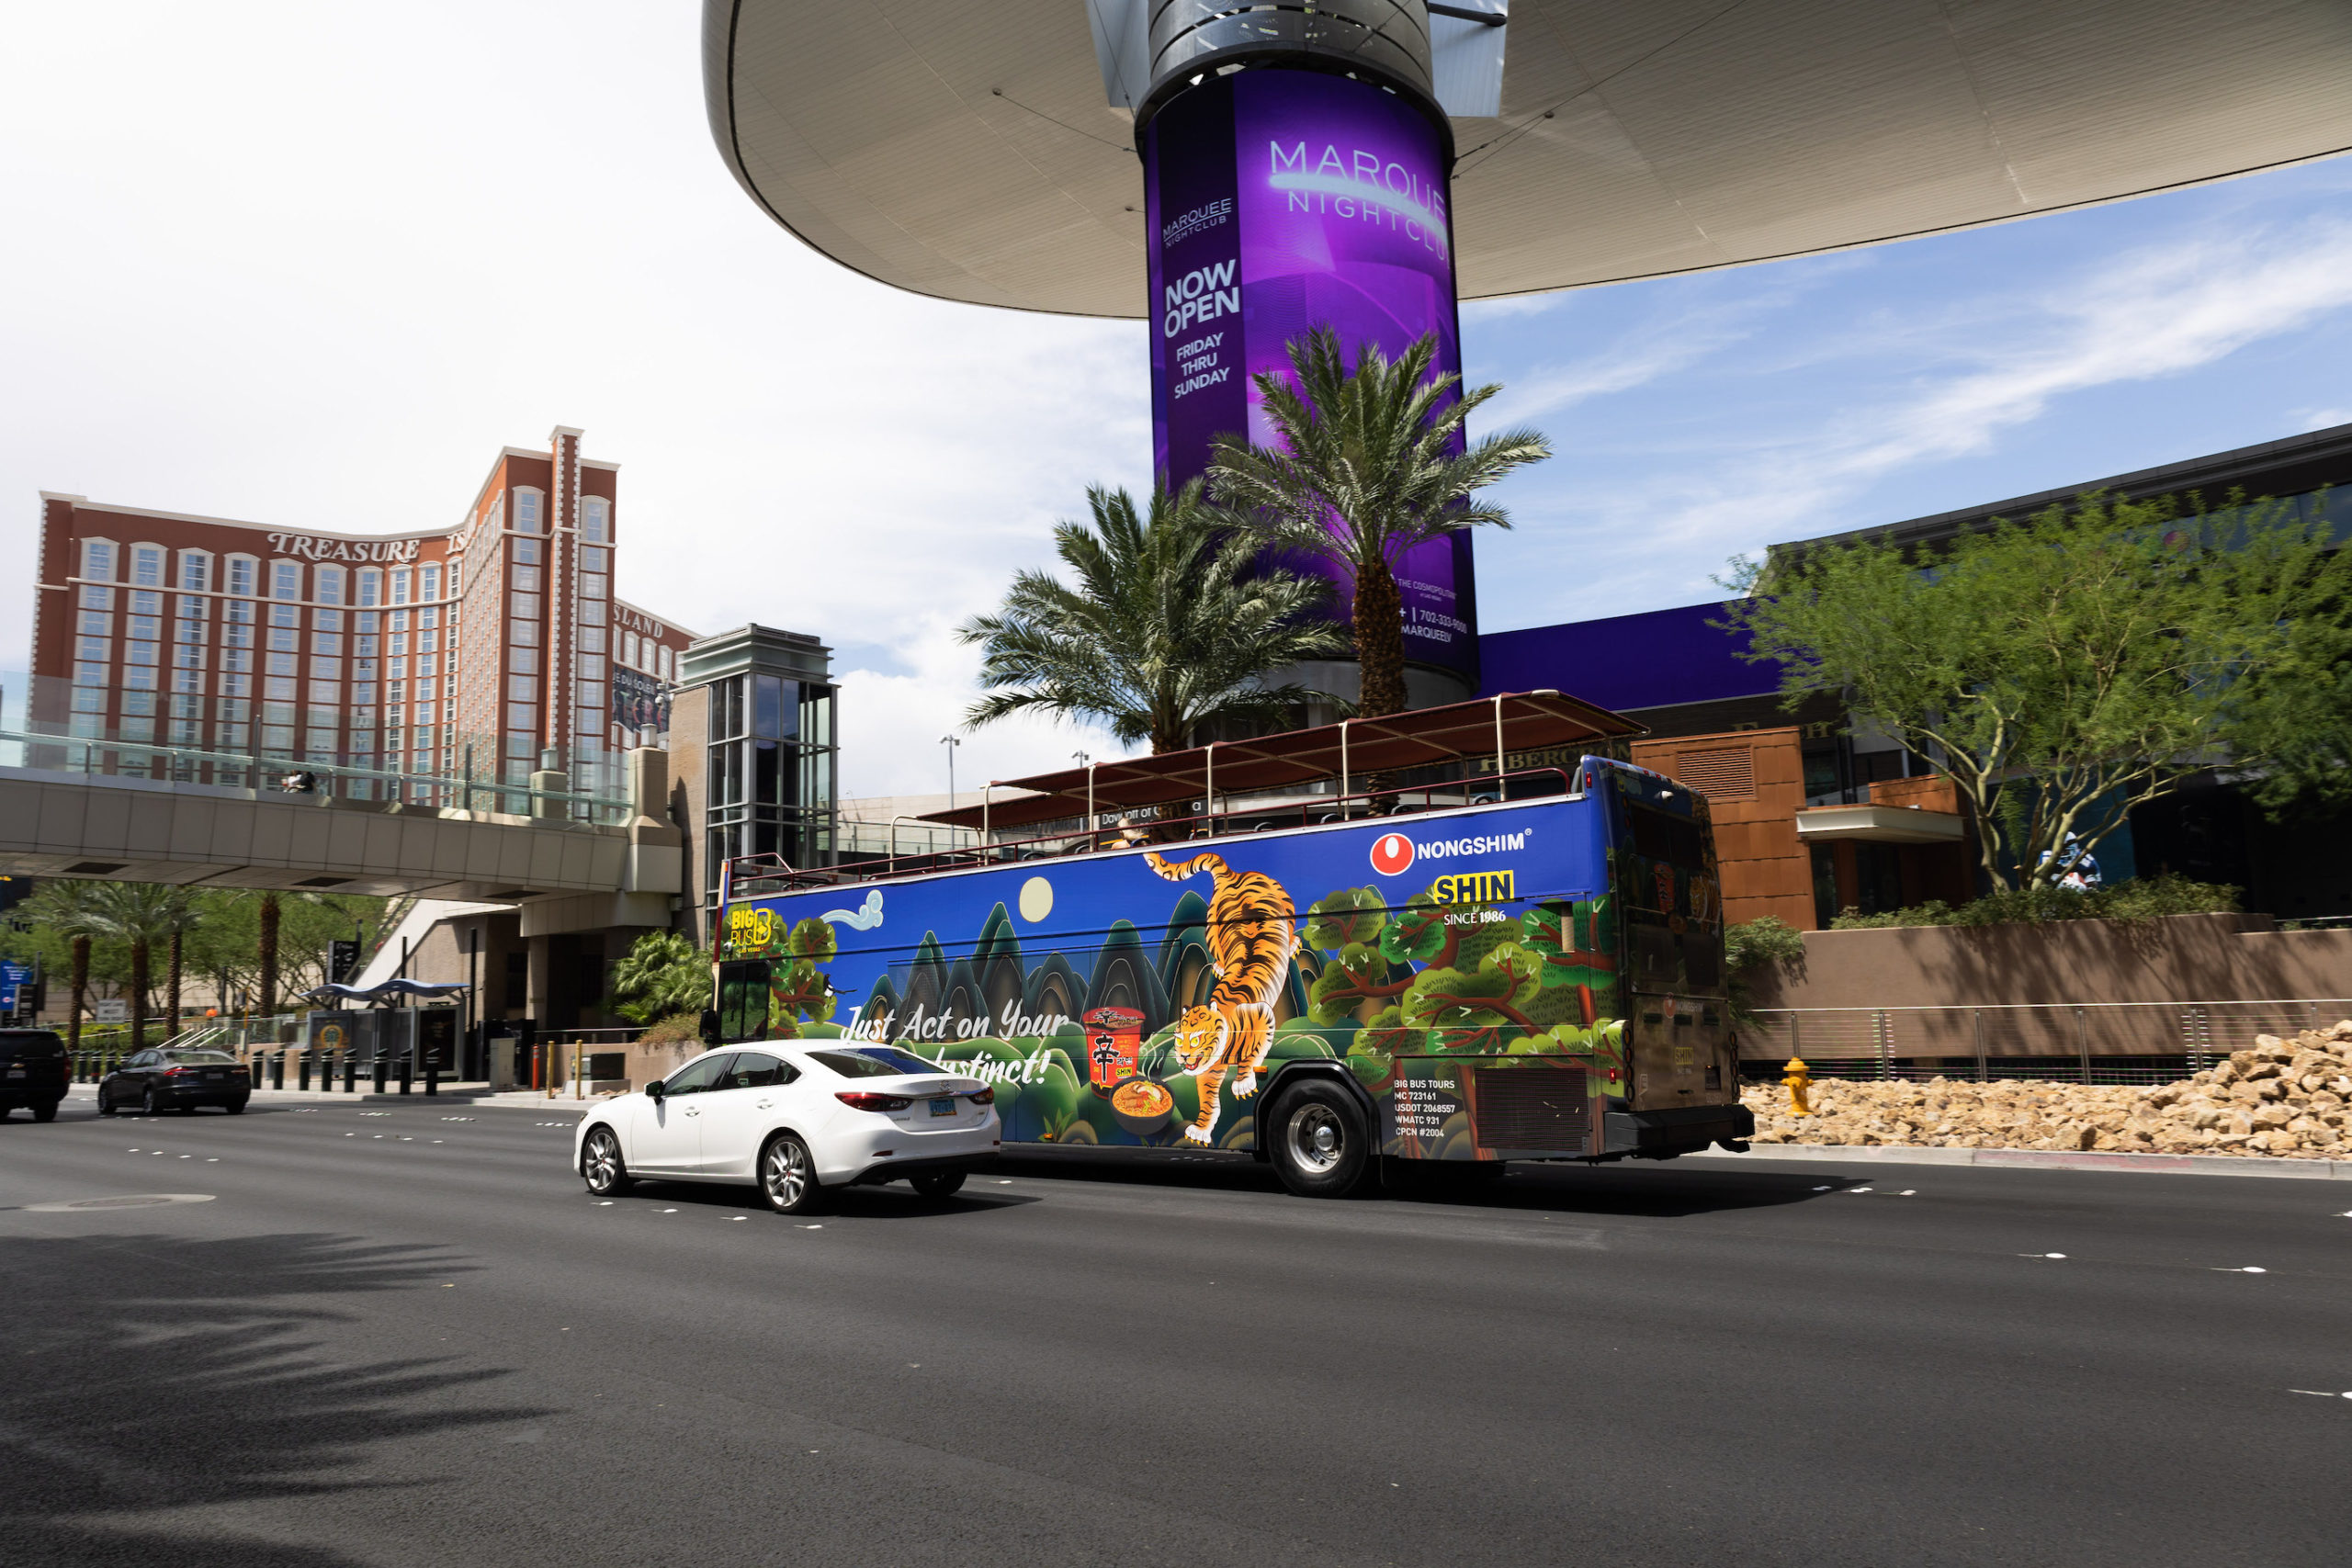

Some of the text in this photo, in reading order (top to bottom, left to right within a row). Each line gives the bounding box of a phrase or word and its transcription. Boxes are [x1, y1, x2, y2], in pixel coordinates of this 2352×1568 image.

[1163, 198, 1231, 239] MARQUEE
[1288, 190, 1450, 269] NIGHTCLU
[1166, 215, 1227, 249] NIGHTCLUB
[1166, 259, 1236, 311] NOW
[1164, 287, 1239, 339] OPEN
[1177, 333, 1224, 362] FRIDAY
[1182, 353, 1217, 377] THRU
[1174, 367, 1230, 400] SUNDAY
[267, 532, 420, 563] TREASURE
[1397, 578, 1412, 589] THE
[614, 604, 663, 638] SLAND
[1434, 871, 1513, 907] SHIN
[731, 909, 753, 930] BIG
[1443, 909, 1507, 926] SINCE 1986
[730, 929, 753, 947] BUS
[840, 998, 1069, 1045] Just Act on Your
[1116, 1067, 1132, 1076] SHIN
[1394, 1079, 1455, 1089] BIG BUS TOURS
[1394, 1091, 1436, 1100] MC 723161
[1395, 1103, 1455, 1113] USDOT 2068557
[1395, 1115, 1440, 1124] WMATC 931
[1396, 1127, 1444, 1137] CPCN #2004
